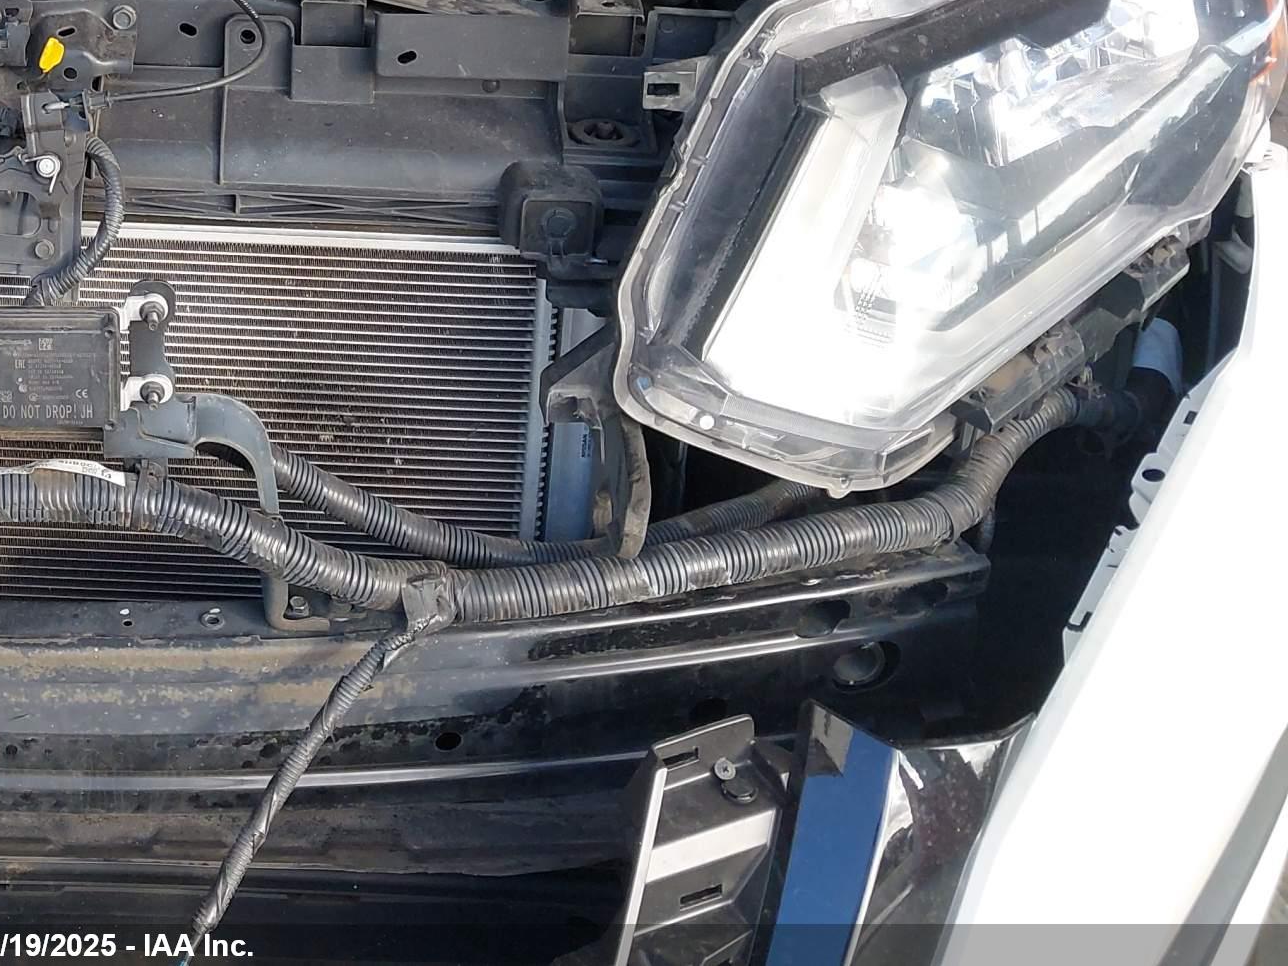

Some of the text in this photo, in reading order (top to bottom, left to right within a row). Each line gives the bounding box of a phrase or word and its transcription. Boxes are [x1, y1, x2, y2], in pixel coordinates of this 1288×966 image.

[2, 404, 93, 419] DO NOT DROP! JH
